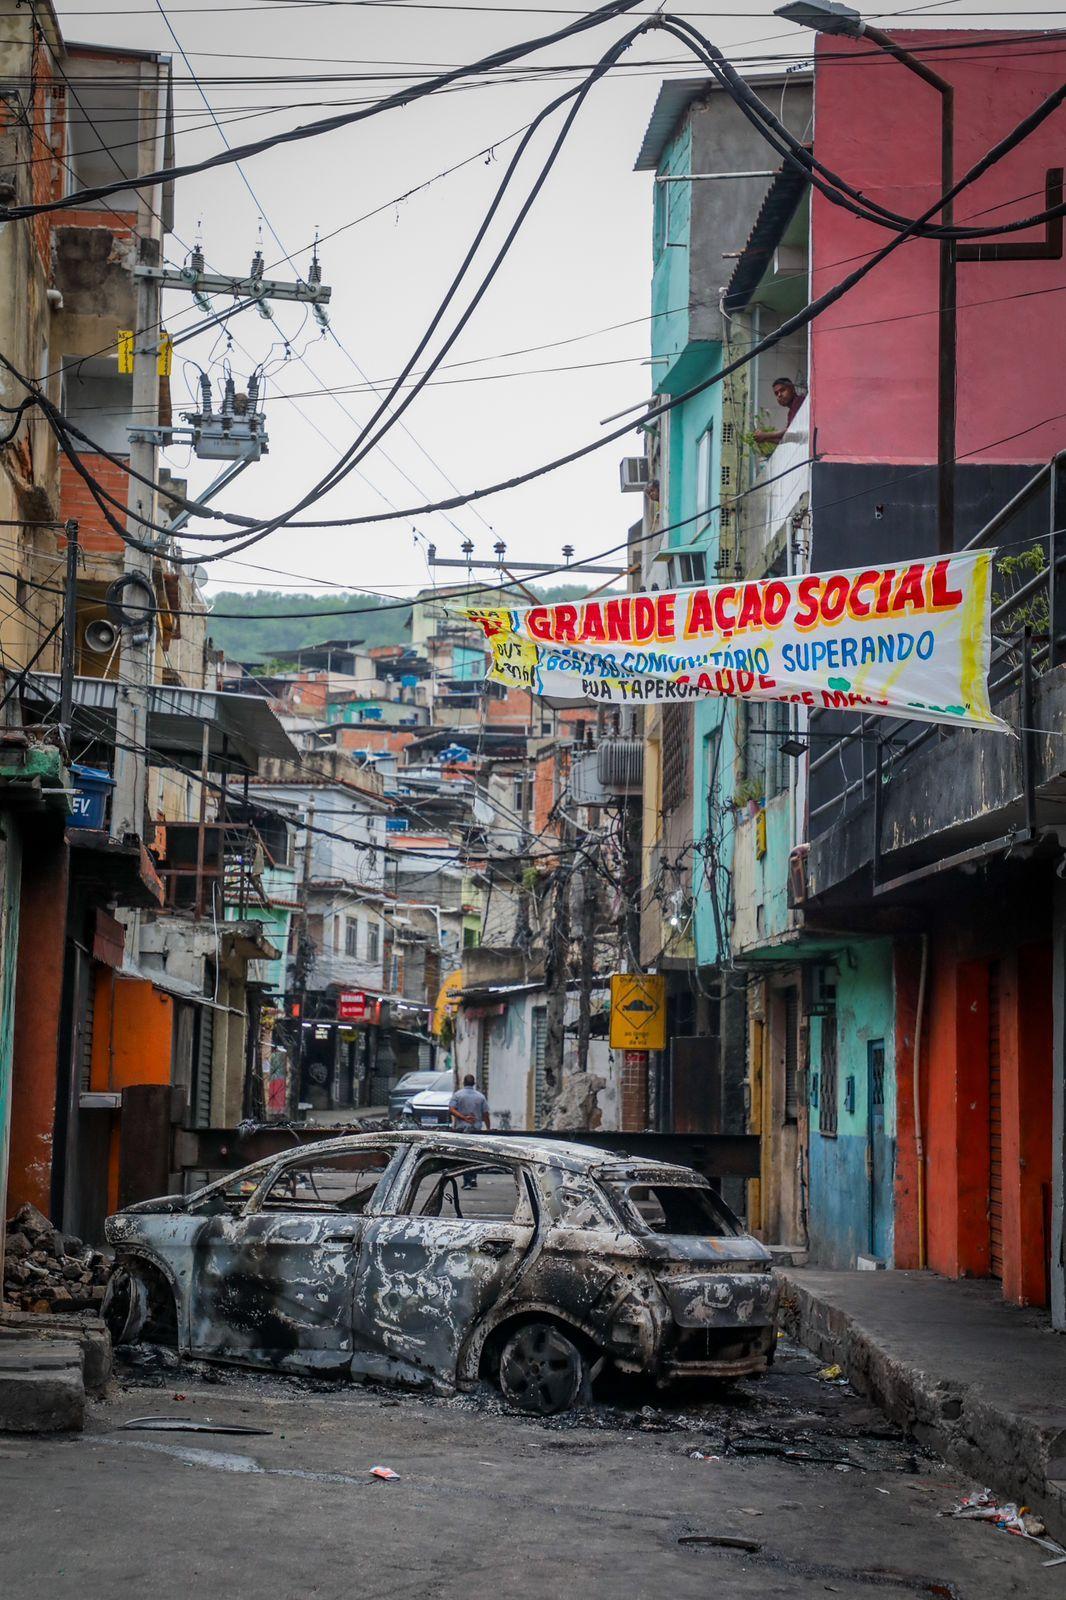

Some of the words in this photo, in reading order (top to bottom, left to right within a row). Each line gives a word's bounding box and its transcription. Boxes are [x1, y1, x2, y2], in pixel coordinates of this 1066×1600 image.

[525, 593, 677, 646] GRANDE
[794, 559, 963, 633] SOCIAL
[781, 630, 935, 673] SUPERANDO
